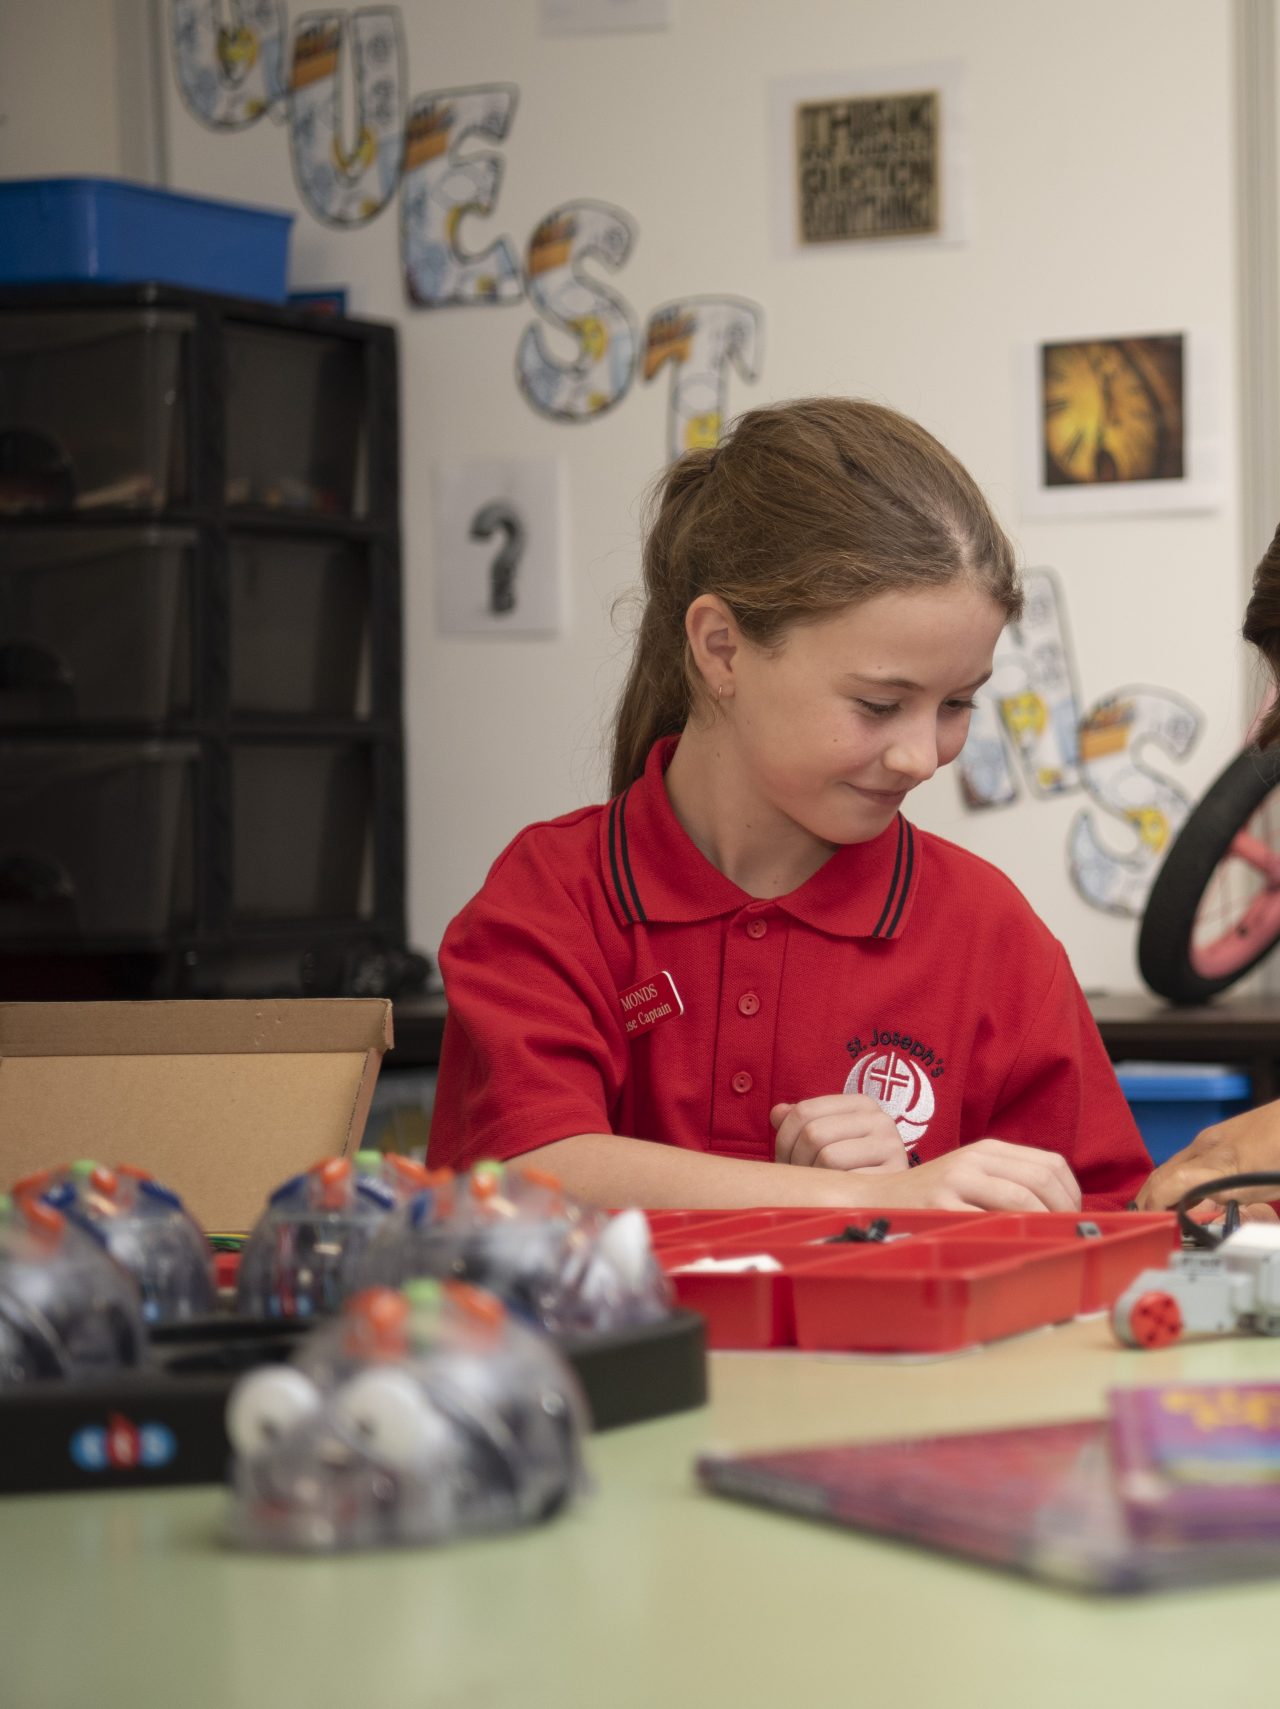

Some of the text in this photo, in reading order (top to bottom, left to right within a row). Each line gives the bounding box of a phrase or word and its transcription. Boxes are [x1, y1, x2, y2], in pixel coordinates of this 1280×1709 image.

[637, 1002, 672, 1025] Captain
[846, 1028, 945, 1079] St. Joseph's
